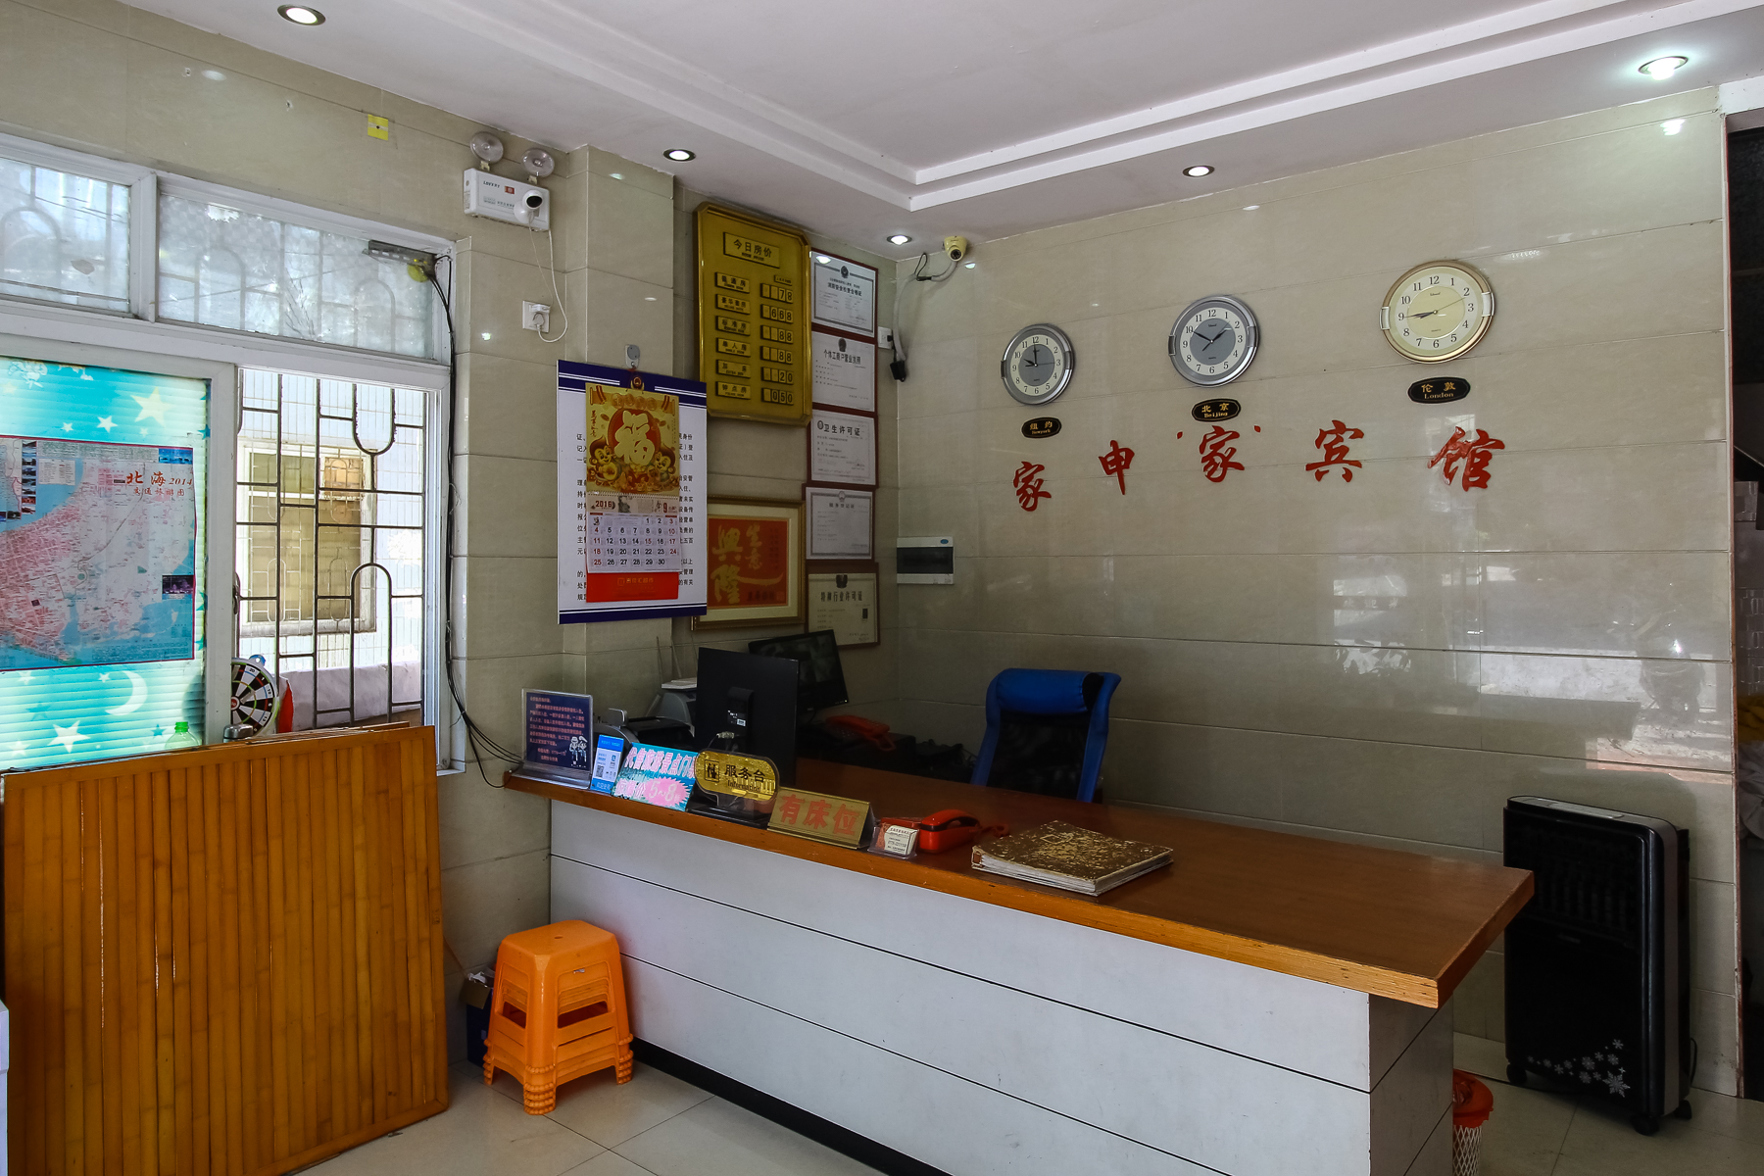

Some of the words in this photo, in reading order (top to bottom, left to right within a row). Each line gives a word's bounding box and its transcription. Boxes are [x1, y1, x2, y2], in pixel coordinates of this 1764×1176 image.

[734, 239, 772, 258] 今日房价
[1429, 276, 1440, 285] 12
[1413, 283, 1422, 291] 11
[1464, 288, 1470, 296] 2
[780, 290, 792, 302] 78
[1401, 296, 1410, 304] 10
[1468, 303, 1474, 312] 3
[772, 308, 792, 320] 668
[1462, 320, 1468, 328] 4
[779, 331, 792, 341] 88
[1403, 328, 1409, 336] 8
[1416, 338, 1422, 346] 7
[1451, 334, 1457, 342] 5
[1433, 340, 1439, 348] 6
[779, 351, 792, 362] 88
[780, 372, 793, 382] 20
[1421, 382, 1456, 392] 伦敦
[773, 391, 793, 402] 050
[1202, 402, 1230, 412] 北京
[824, 424, 860, 436] 卫生许可证
[1030, 421, 1052, 430] 纽约
[127, 471, 166, 486] 北海
[168, 478, 193, 486] 2014
[725, 764, 765, 782] 服务台
[779, 794, 860, 836] 有床位
